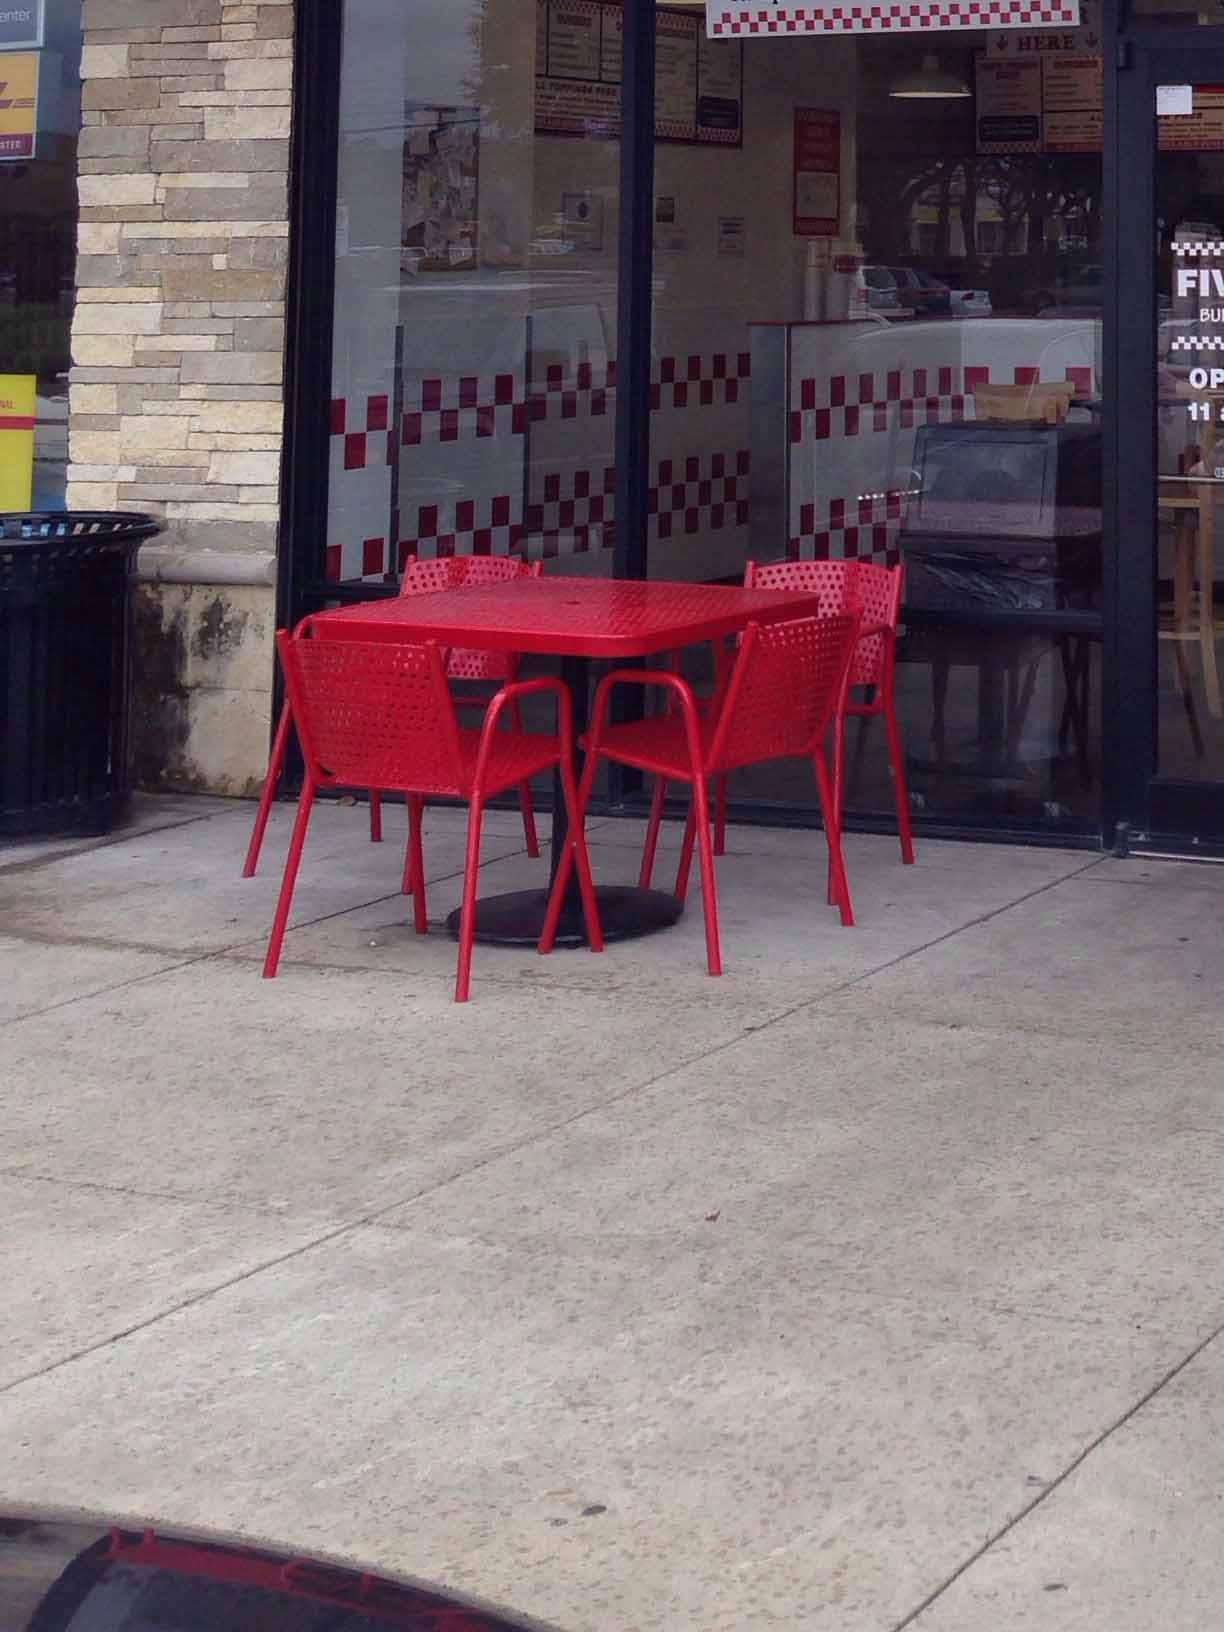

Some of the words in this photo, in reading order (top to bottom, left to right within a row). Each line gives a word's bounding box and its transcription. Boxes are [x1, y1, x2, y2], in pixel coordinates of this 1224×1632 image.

[0, 9, 33, 23] enter
[1017, 34, 1074, 51] HERE
[1187, 402, 1210, 421] 11
